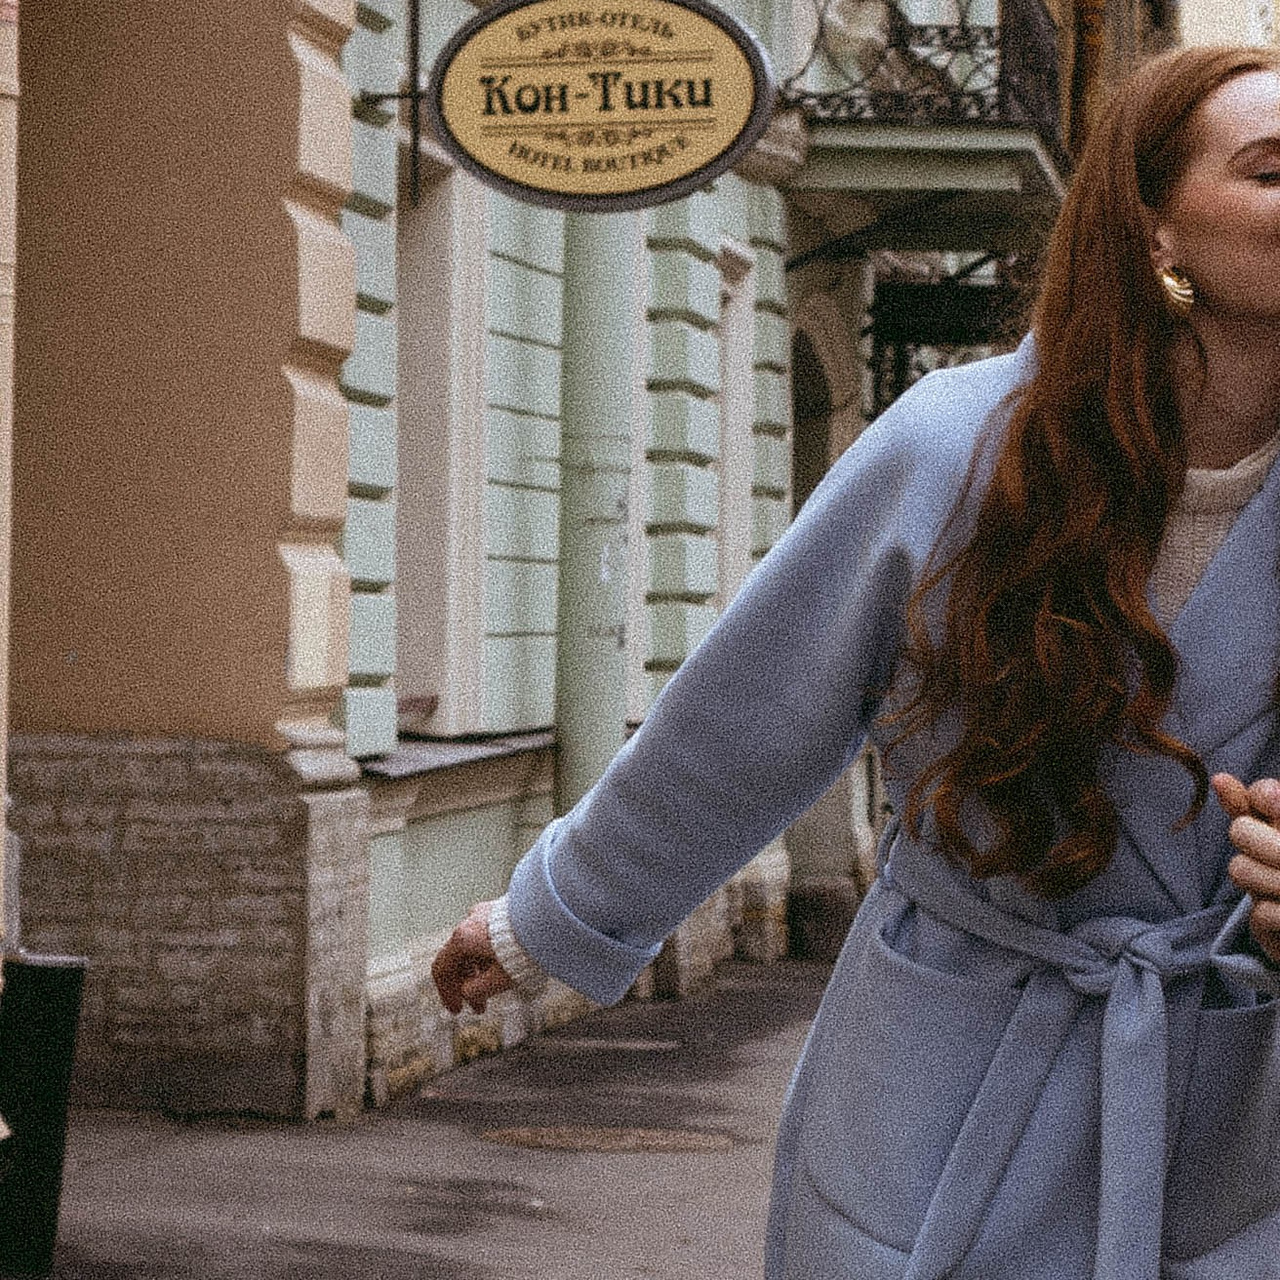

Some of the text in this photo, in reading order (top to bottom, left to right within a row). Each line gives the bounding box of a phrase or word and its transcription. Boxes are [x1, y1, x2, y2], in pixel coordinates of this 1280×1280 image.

[515, 10, 675, 43] БУТИК-ОТЕЛЬ
[479, 71, 714, 116] Кон-Тики
[508, 138, 577, 173] HOTEL
